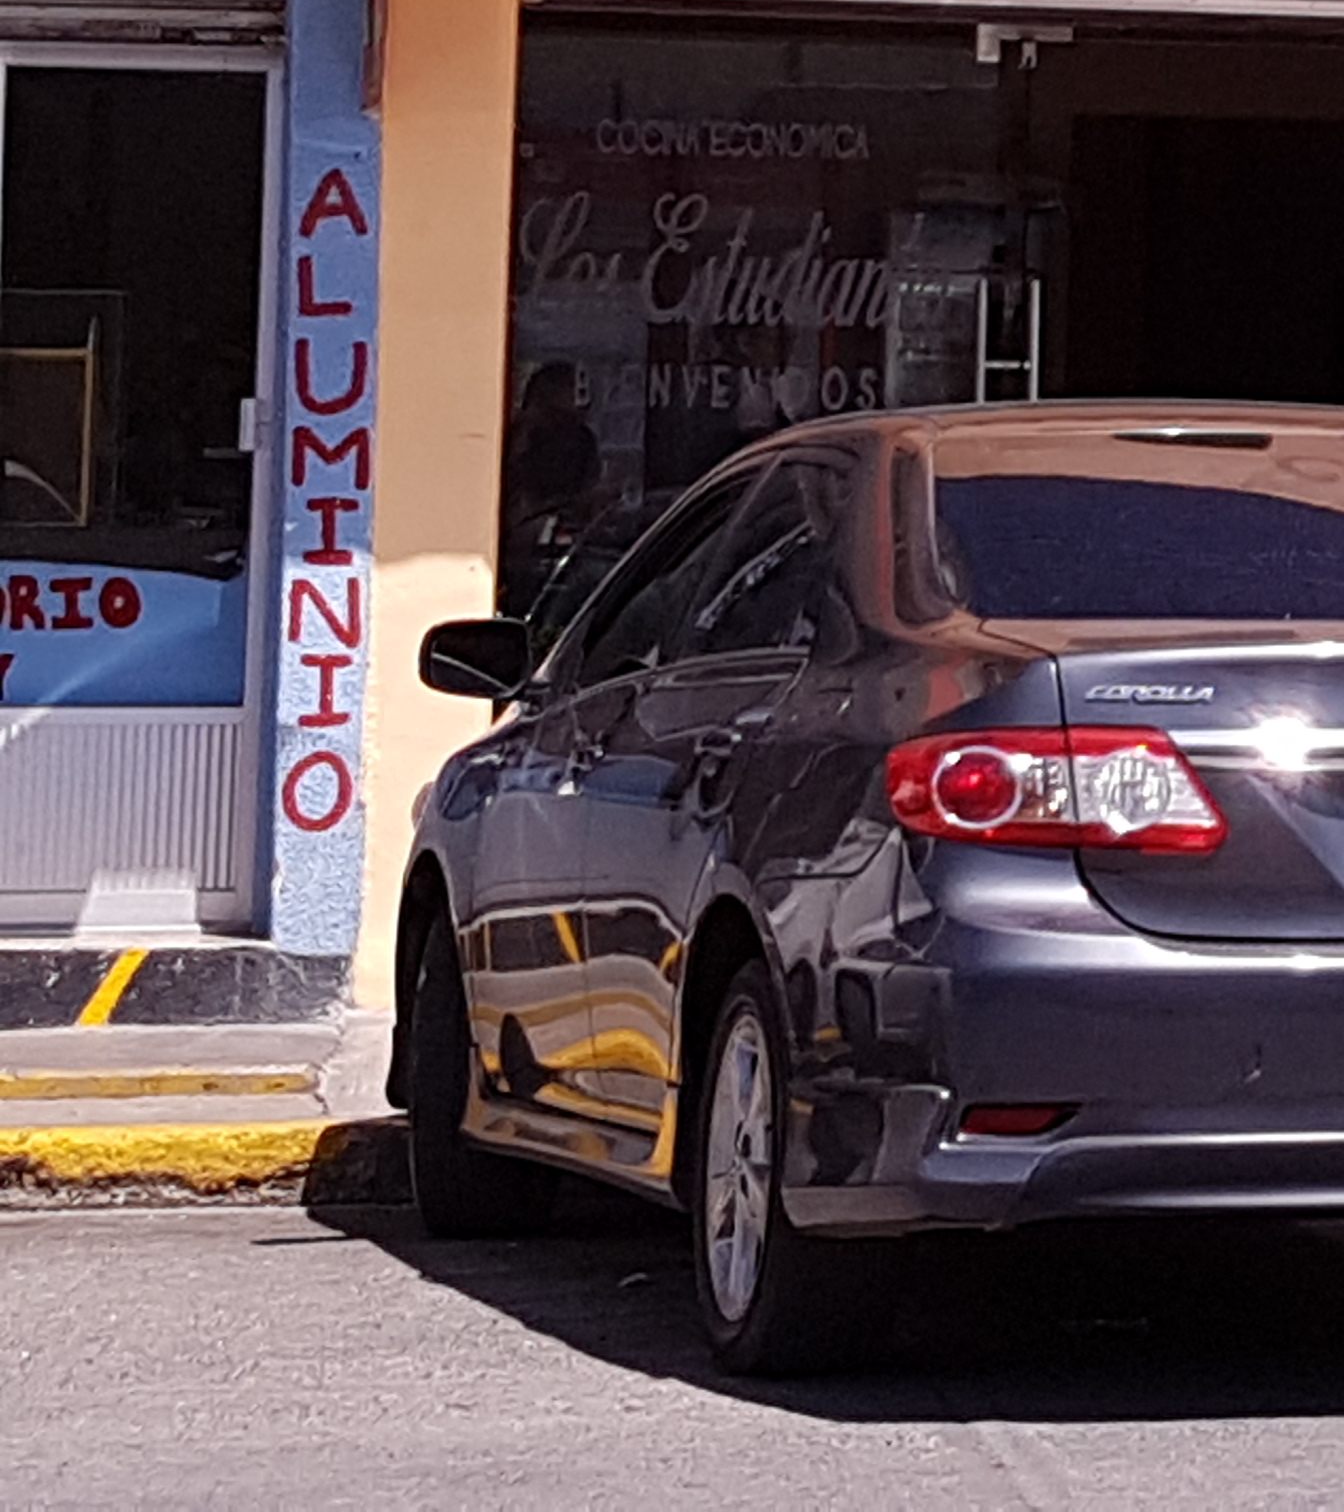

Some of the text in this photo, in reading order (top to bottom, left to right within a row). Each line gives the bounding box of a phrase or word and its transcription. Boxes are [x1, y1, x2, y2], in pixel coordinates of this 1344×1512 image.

[595, 118, 870, 161] COCINA ECONOMICA
[642, 192, 915, 327] Estudian
[573, 361, 878, 410] BENVENIDOS
[282, 168, 370, 832] ALUMINIO
[0, 575, 142, 630] RIO
[1084, 684, 1216, 704] COROLLA
